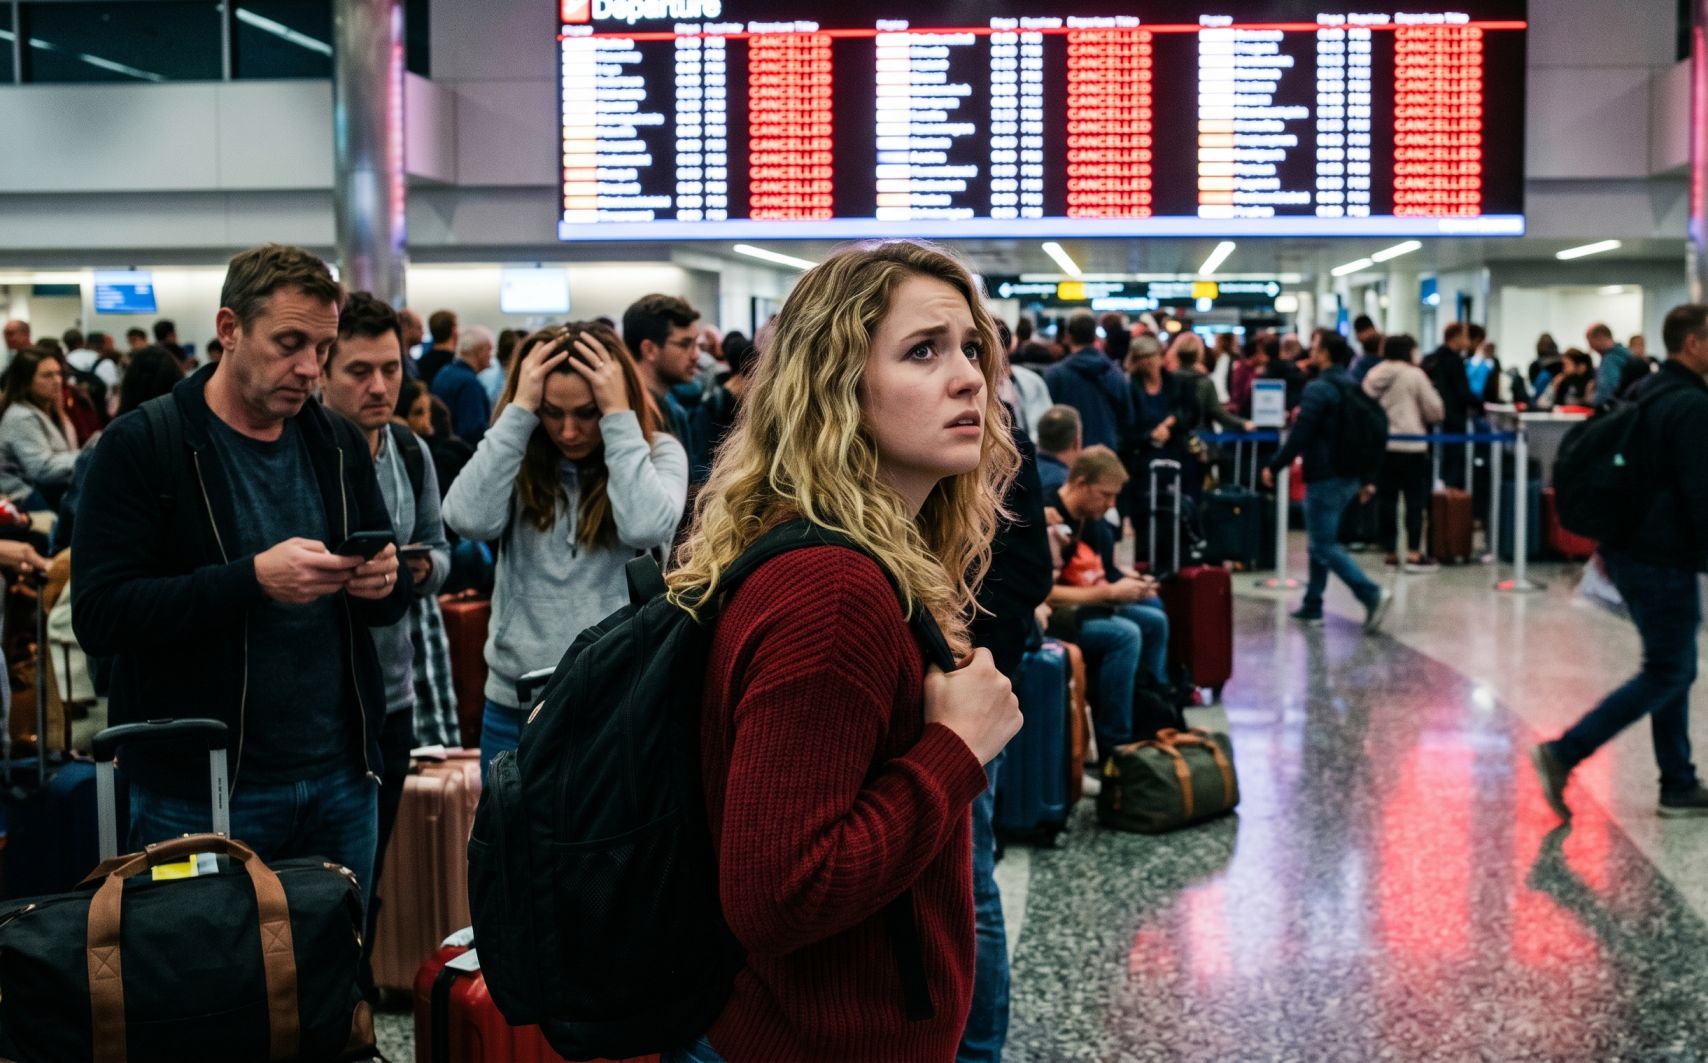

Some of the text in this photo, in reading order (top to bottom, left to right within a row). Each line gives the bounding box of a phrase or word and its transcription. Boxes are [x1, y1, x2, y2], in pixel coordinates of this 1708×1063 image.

[1067, 31, 1152, 43] CANCELLED
[1395, 28, 1483, 40] CANCELLED
[1067, 43, 1152, 56] CANCELLED
[1395, 40, 1483, 53] CANCELLED
[1067, 56, 1152, 69] CANCELLED
[1395, 53, 1483, 66] CANCELLED
[1067, 69, 1152, 82] CANCELLED
[1395, 66, 1483, 79] CANCELLED
[1067, 82, 1152, 94] CANCELLED
[1394, 79, 1483, 92] CANCELLED
[1067, 94, 1152, 107] CANCELLED
[1394, 92, 1483, 105] CANCELLED
[1067, 107, 1152, 120] CANCELLED
[1394, 105, 1483, 118] CANCELLED
[1067, 120, 1152, 134] CANCELLED
[1394, 118, 1482, 132] CANCELLED
[1067, 134, 1152, 148] CANCELLED
[1394, 132, 1482, 146] CANCELLED
[1067, 148, 1152, 163] CANCELLED
[1394, 146, 1482, 161] CANCELLED
[1067, 163, 1152, 177] CANCELLED
[1393, 161, 1482, 175] CANCELLED
[1067, 177, 1152, 191] CANCELLED
[1393, 175, 1482, 190] CANCELLED
[1067, 191, 1152, 205] CANCELLED
[1393, 190, 1482, 204] CANCELLED
[1067, 205, 1152, 218] CANCELLED
[1393, 204, 1482, 217] CANCELLED
